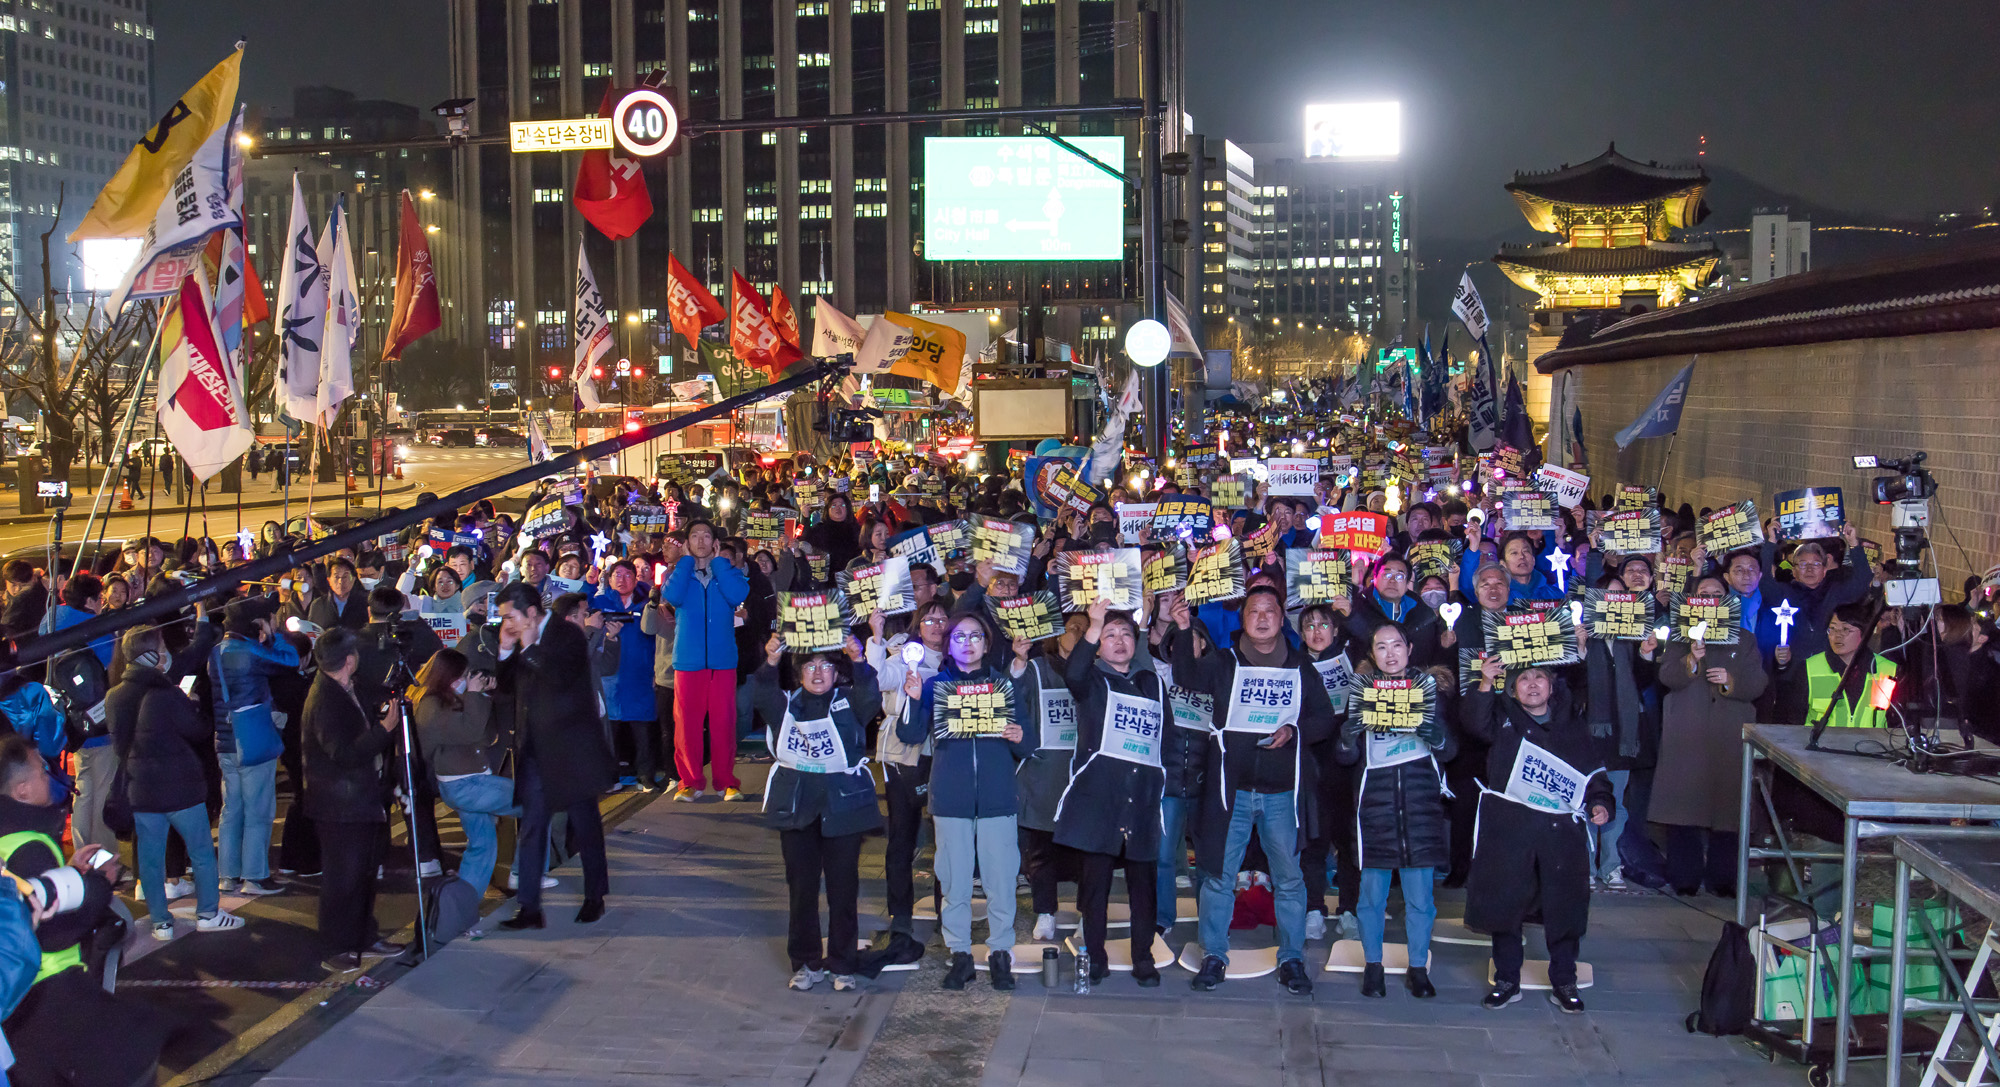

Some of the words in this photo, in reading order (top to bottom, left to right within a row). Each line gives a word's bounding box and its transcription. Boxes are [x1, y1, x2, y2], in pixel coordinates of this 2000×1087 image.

[628, 108, 663, 139] 40
[516, 124, 608, 145] 과속단속장비
[935, 207, 967, 226] 시청
[935, 228, 961, 243] City
[965, 228, 990, 241] Hall
[1392, 211, 1400, 253] 하나은행
[1040, 240, 1071, 252] 100m
[1155, 502, 1184, 516] 내란
[1183, 502, 1211, 516] 종식
[1780, 498, 1807, 516] 내란
[1153, 515, 1180, 529] 민주
[1179, 515, 1209, 528] 수호
[1333, 517, 1376, 532] 윤석열
[1321, 533, 1350, 549] 즉각
[1354, 533, 1382, 548] 파면
[1081, 554, 1111, 564] 내란수괴
[1309, 552, 1337, 561] 내란수괴
[1607, 593, 1633, 601] 내란수괴
[1595, 600, 1646, 615] 윤석열을
[1508, 614, 1540, 624] 내란수괴
[1497, 622, 1561, 641] 윤석열을
[1594, 621, 1645, 635] 파면하라
[1500, 644, 1565, 665] 파면하라
[1242, 678, 1265, 688] 윤석열
[1266, 678, 1293, 689] 즉각파면
[1325, 672, 1350, 690] 농성
[1376, 680, 1407, 689] 내란수괴
[960, 684, 989, 694] 내란수괴
[1363, 687, 1424, 703] 윤석열을
[947, 692, 1006, 709] 윤석열을
[1047, 699, 1069, 708] 윤석열
[1240, 688, 1293, 706] 단식농성
[1048, 709, 1077, 724] 단식
[1115, 703, 1138, 716] 윤석열
[947, 717, 1007, 733] 파면하라
[1362, 711, 1424, 727] 파면하라
[787, 736, 835, 759] 단식농성
[1524, 754, 1548, 772] 윤석열
[1521, 764, 1575, 804] 단식농성
